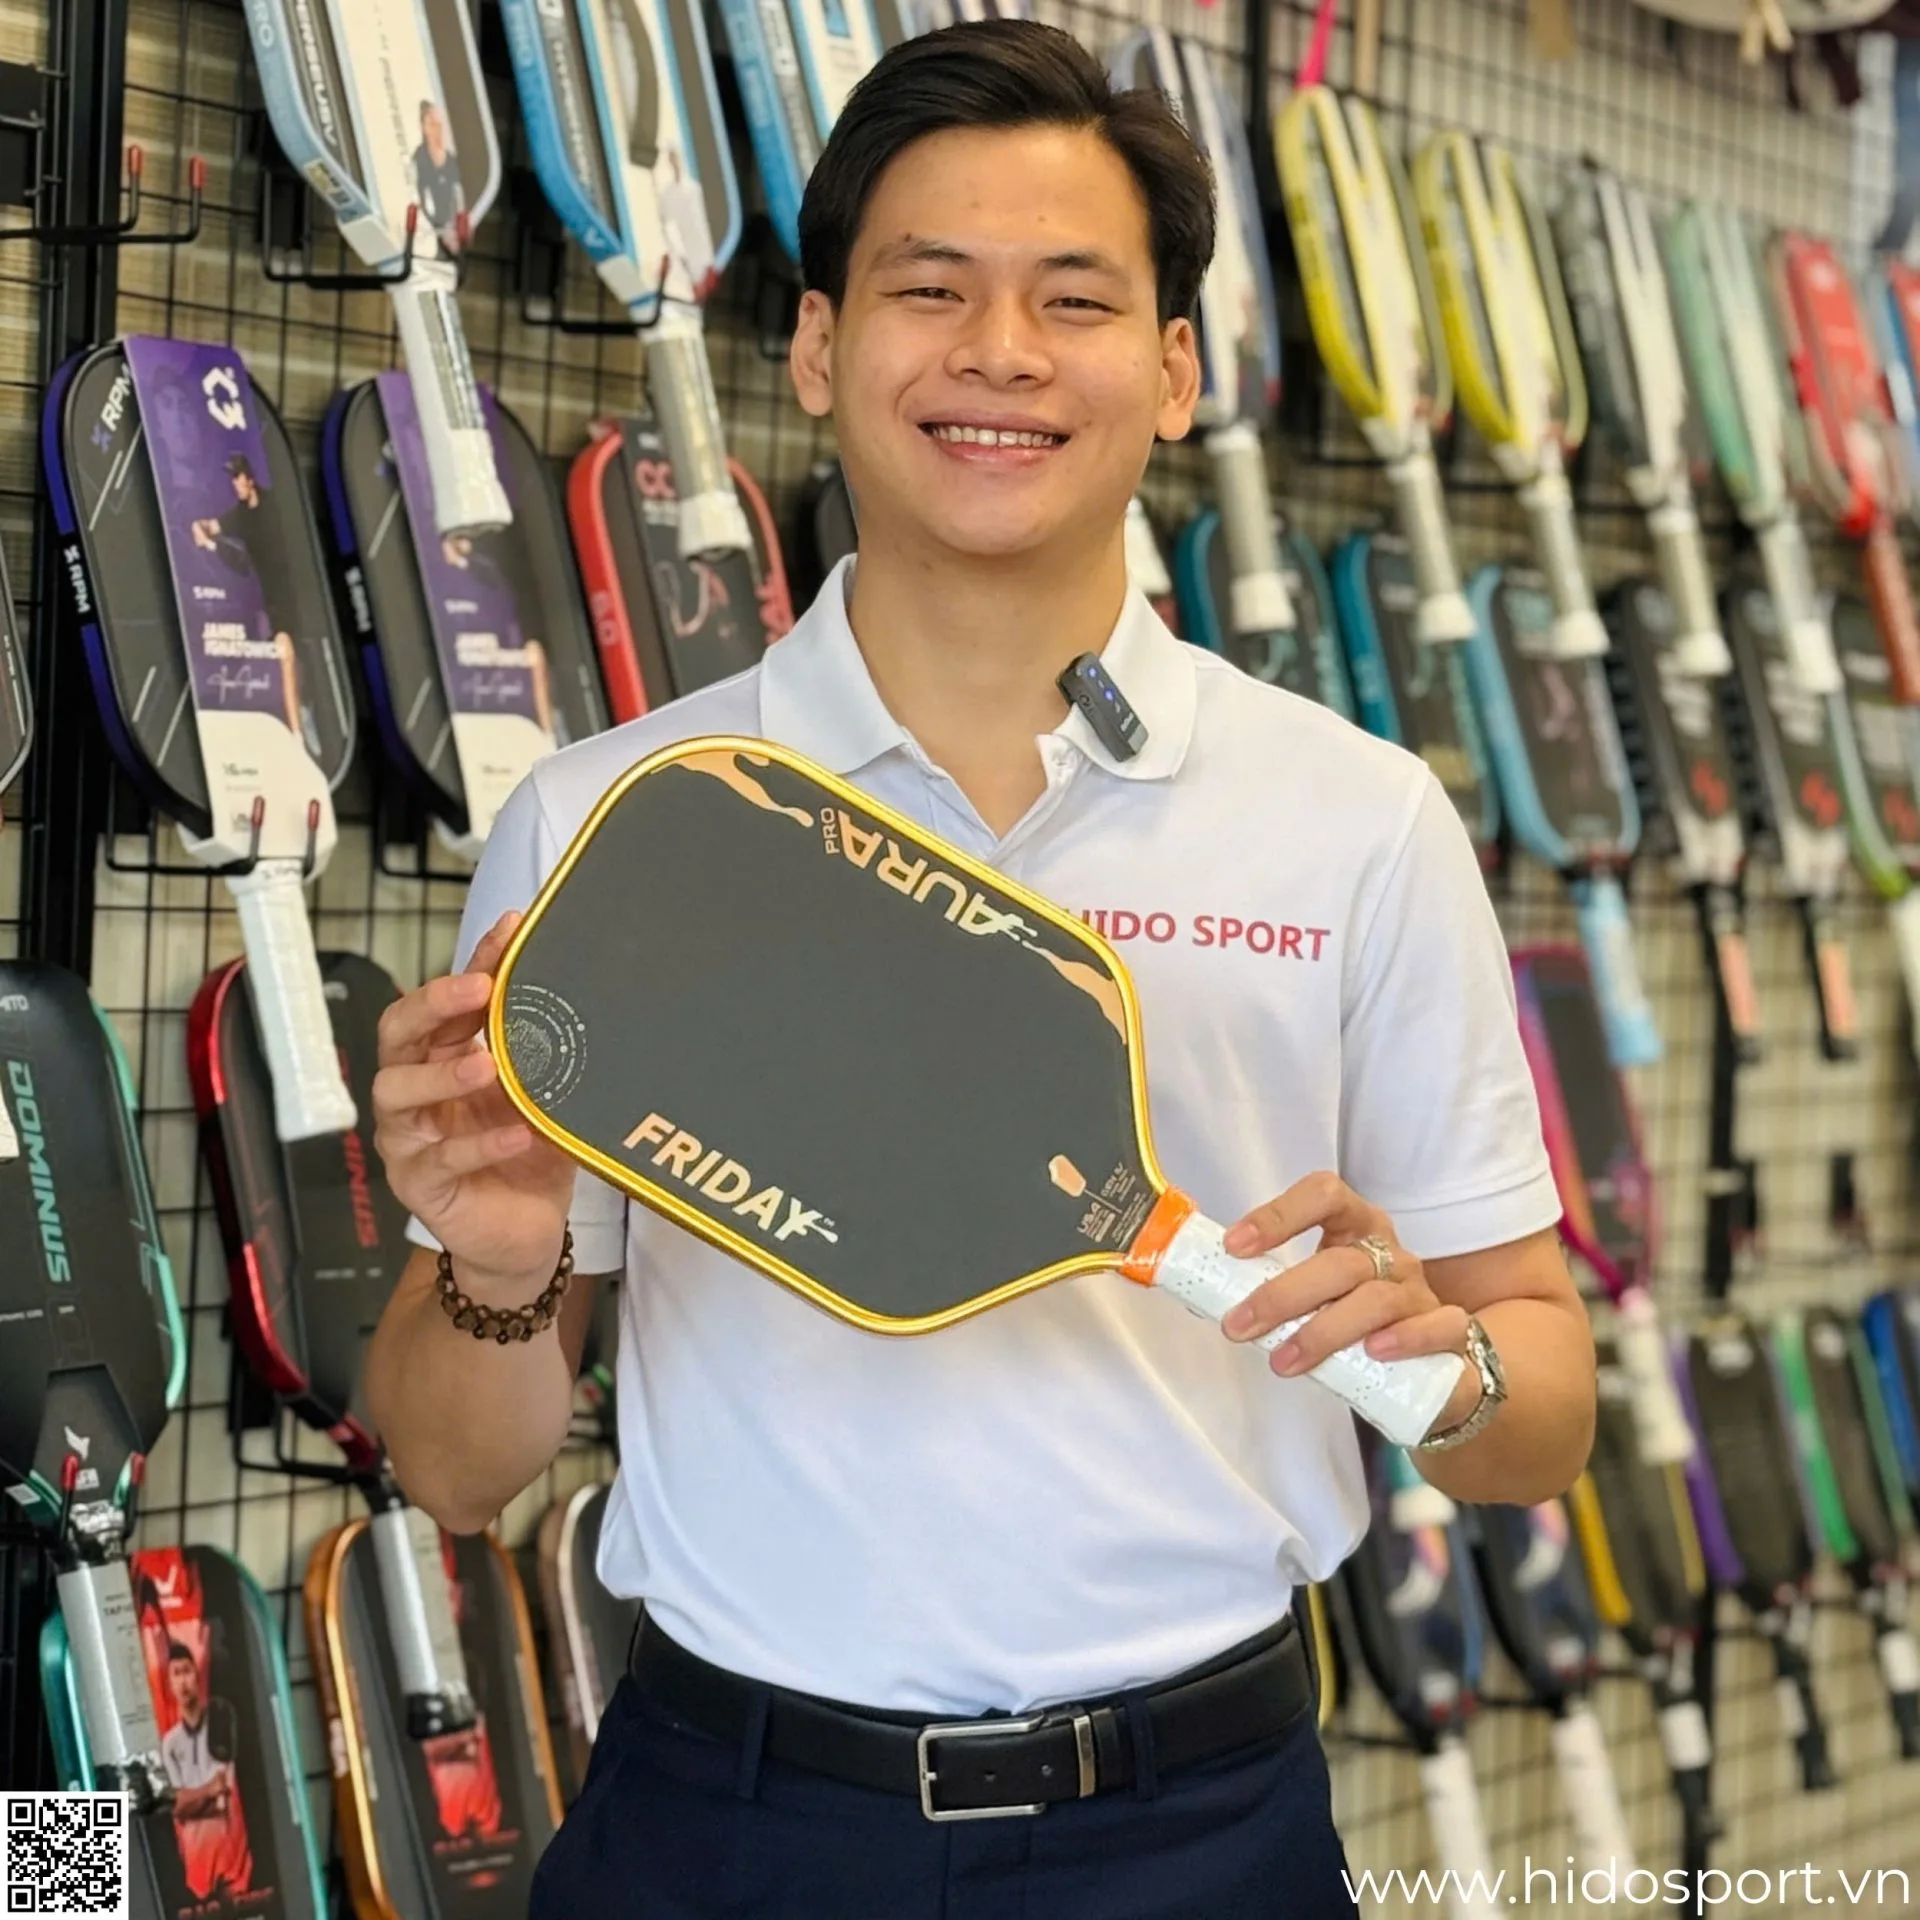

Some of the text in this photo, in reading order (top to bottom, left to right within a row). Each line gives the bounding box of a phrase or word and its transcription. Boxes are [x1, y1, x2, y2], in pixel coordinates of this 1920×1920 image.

[820, 807, 841, 854] PRO
[838, 809, 1036, 938] AURA
[1192, 915, 1331, 962] SPORT
[7, 1059, 71, 1283] DOMINUS
[622, 1112, 836, 1243] FRIDAY
